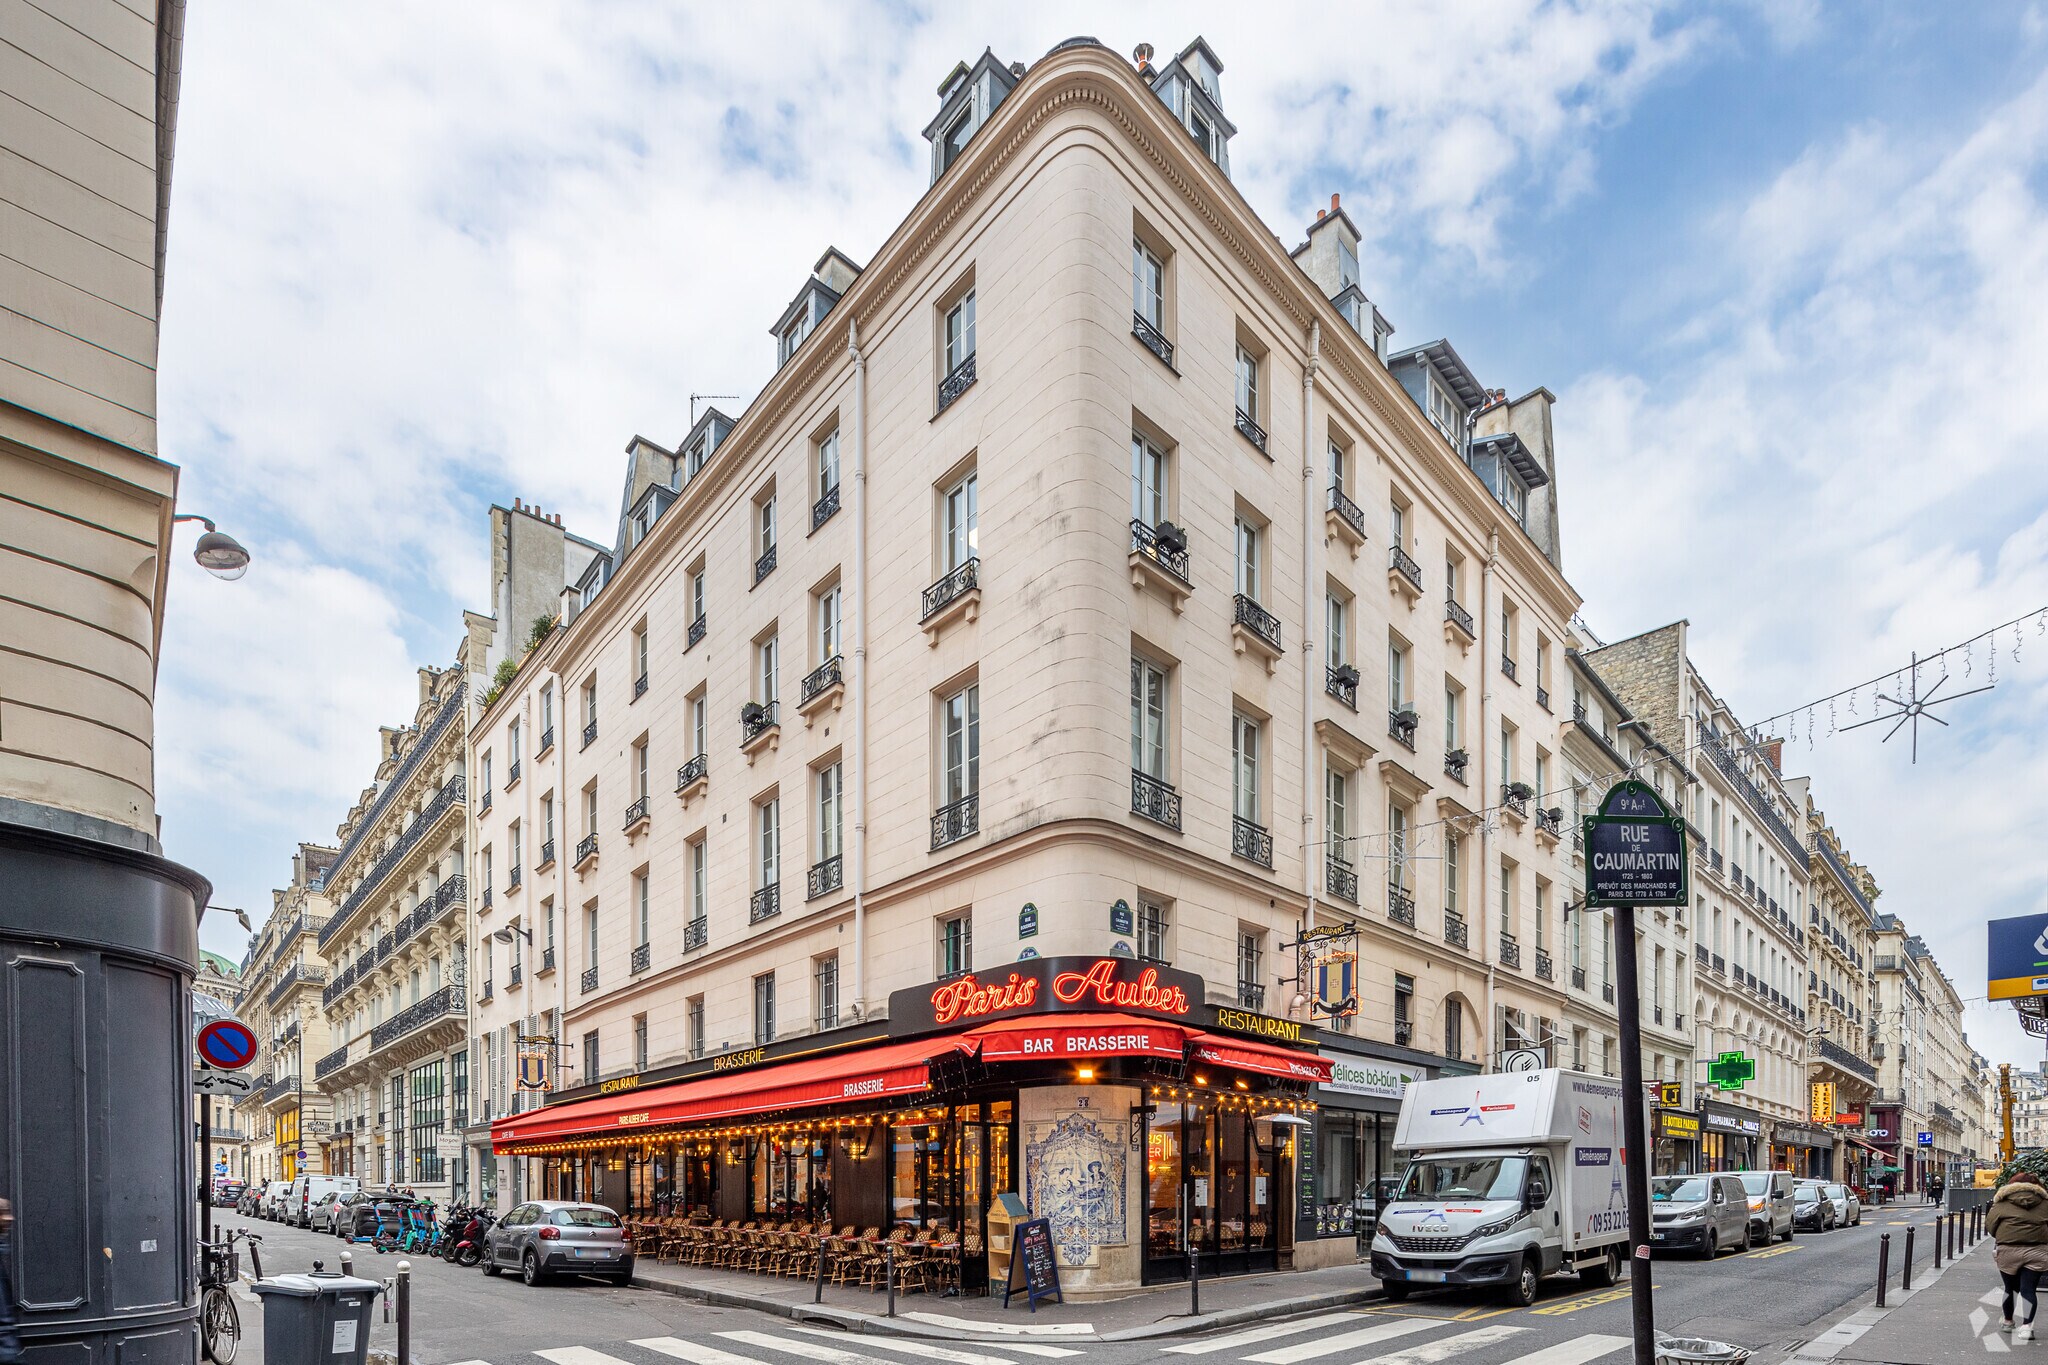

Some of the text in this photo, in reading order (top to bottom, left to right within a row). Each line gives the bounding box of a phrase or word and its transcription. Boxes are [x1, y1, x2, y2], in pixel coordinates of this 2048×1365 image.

[1620, 826, 1650, 842] RUE
[1594, 853, 1680, 870] CAUMARTIN
[1303, 925, 1345, 940] RESTAURANT
[931, 960, 1190, 1024] Paris Auber
[1218, 1008, 1302, 1041] RESTAURANT
[1024, 1035, 1149, 1054] BAR BRASSERIE
[714, 1048, 765, 1071] BRASSERIE
[600, 1075, 639, 1094] RESTAURANT
[1366, 1068, 1397, 1088] bò-bún
[844, 1078, 884, 1098] BRASSERIE
[618, 1115, 628, 1125] PARIS
[639, 1113, 650, 1123] CAFE
[1662, 1115, 1667, 1126] LE
[1683, 1118, 1699, 1130] PARISIEN
[1708, 1114, 1735, 1128] PARAPHARMACIE
[1579, 1150, 1609, 1163] Déménageurs
[1593, 1213, 1602, 1233] 09
[1604, 1212, 1612, 1231] 53
[1613, 1211, 1621, 1229] 22
